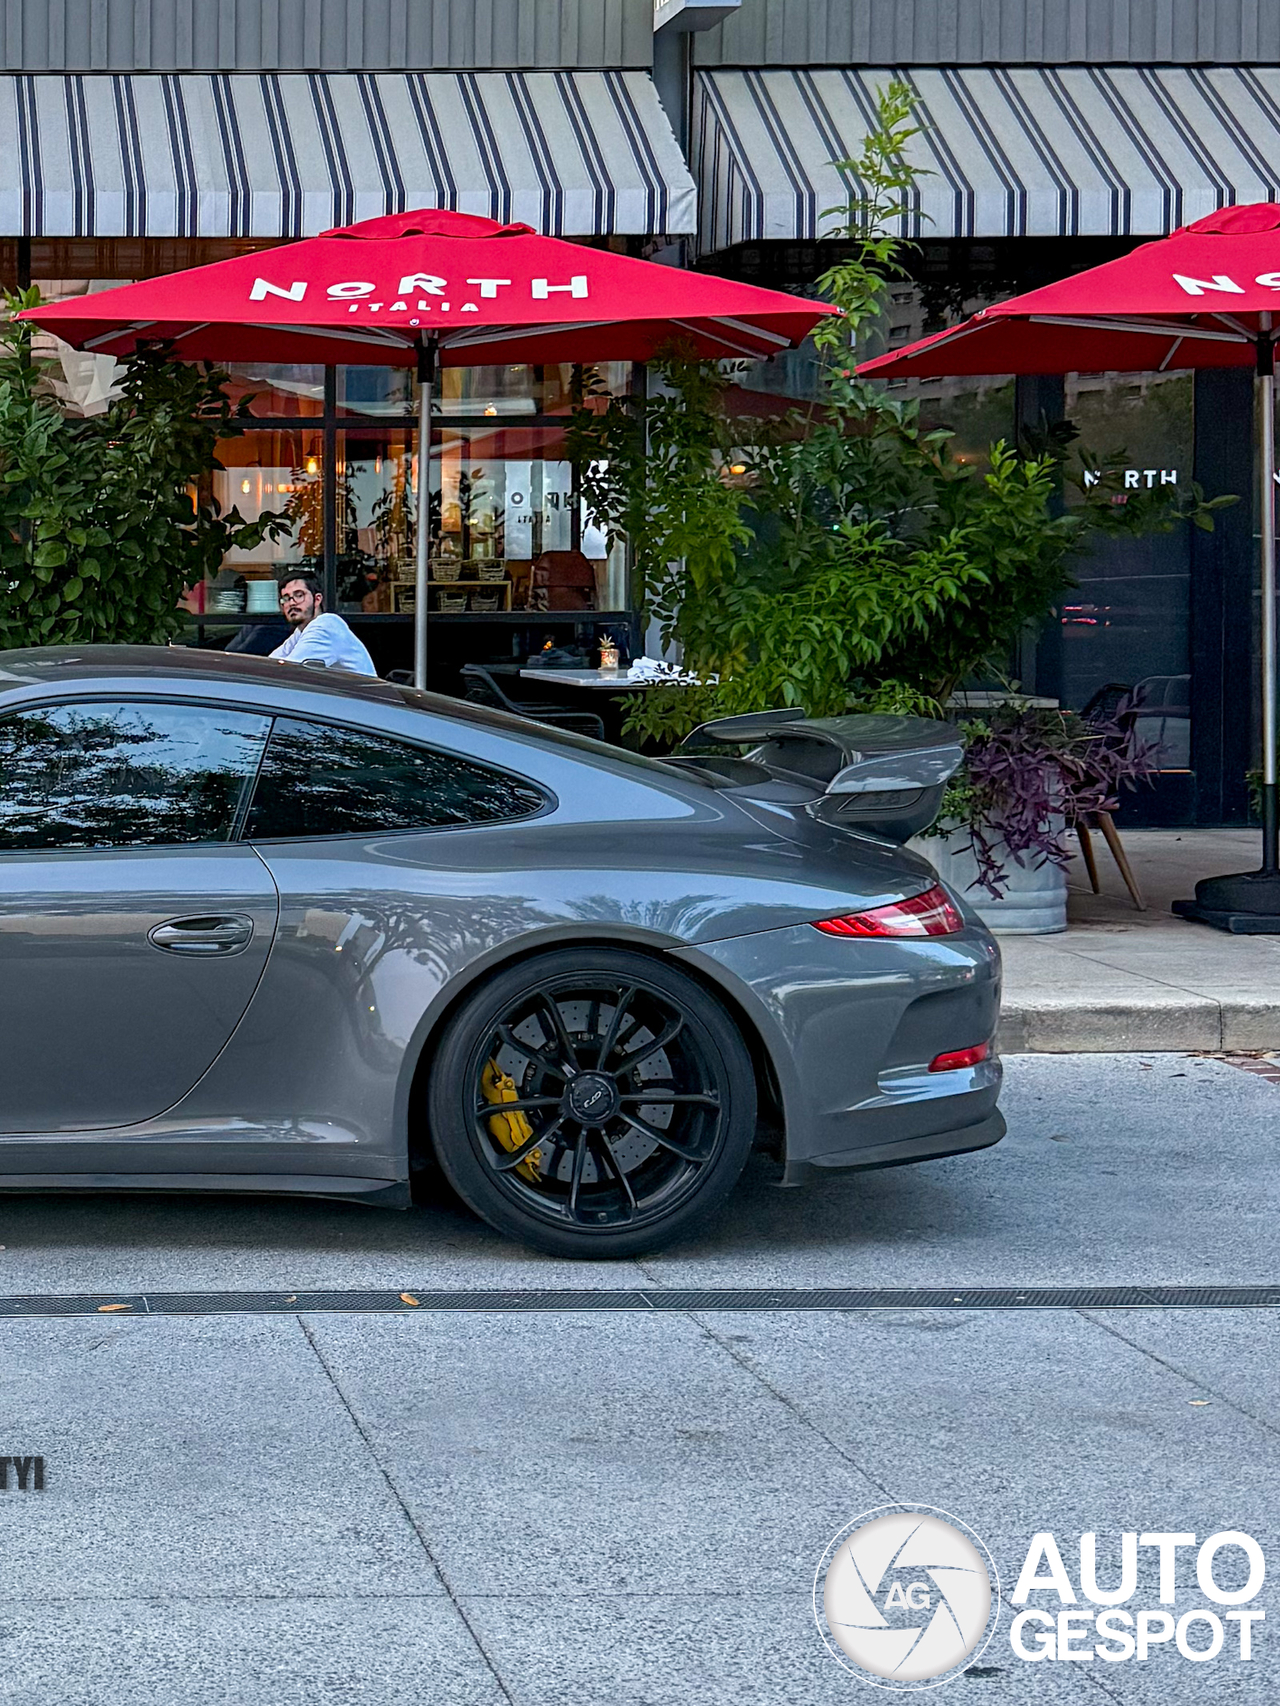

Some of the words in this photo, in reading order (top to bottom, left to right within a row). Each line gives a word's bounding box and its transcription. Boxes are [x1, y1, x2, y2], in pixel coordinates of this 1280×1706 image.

[249, 272, 589, 301] NORTH
[348, 299, 480, 312] ITALIA
[1083, 469, 1178, 488] NRTH
